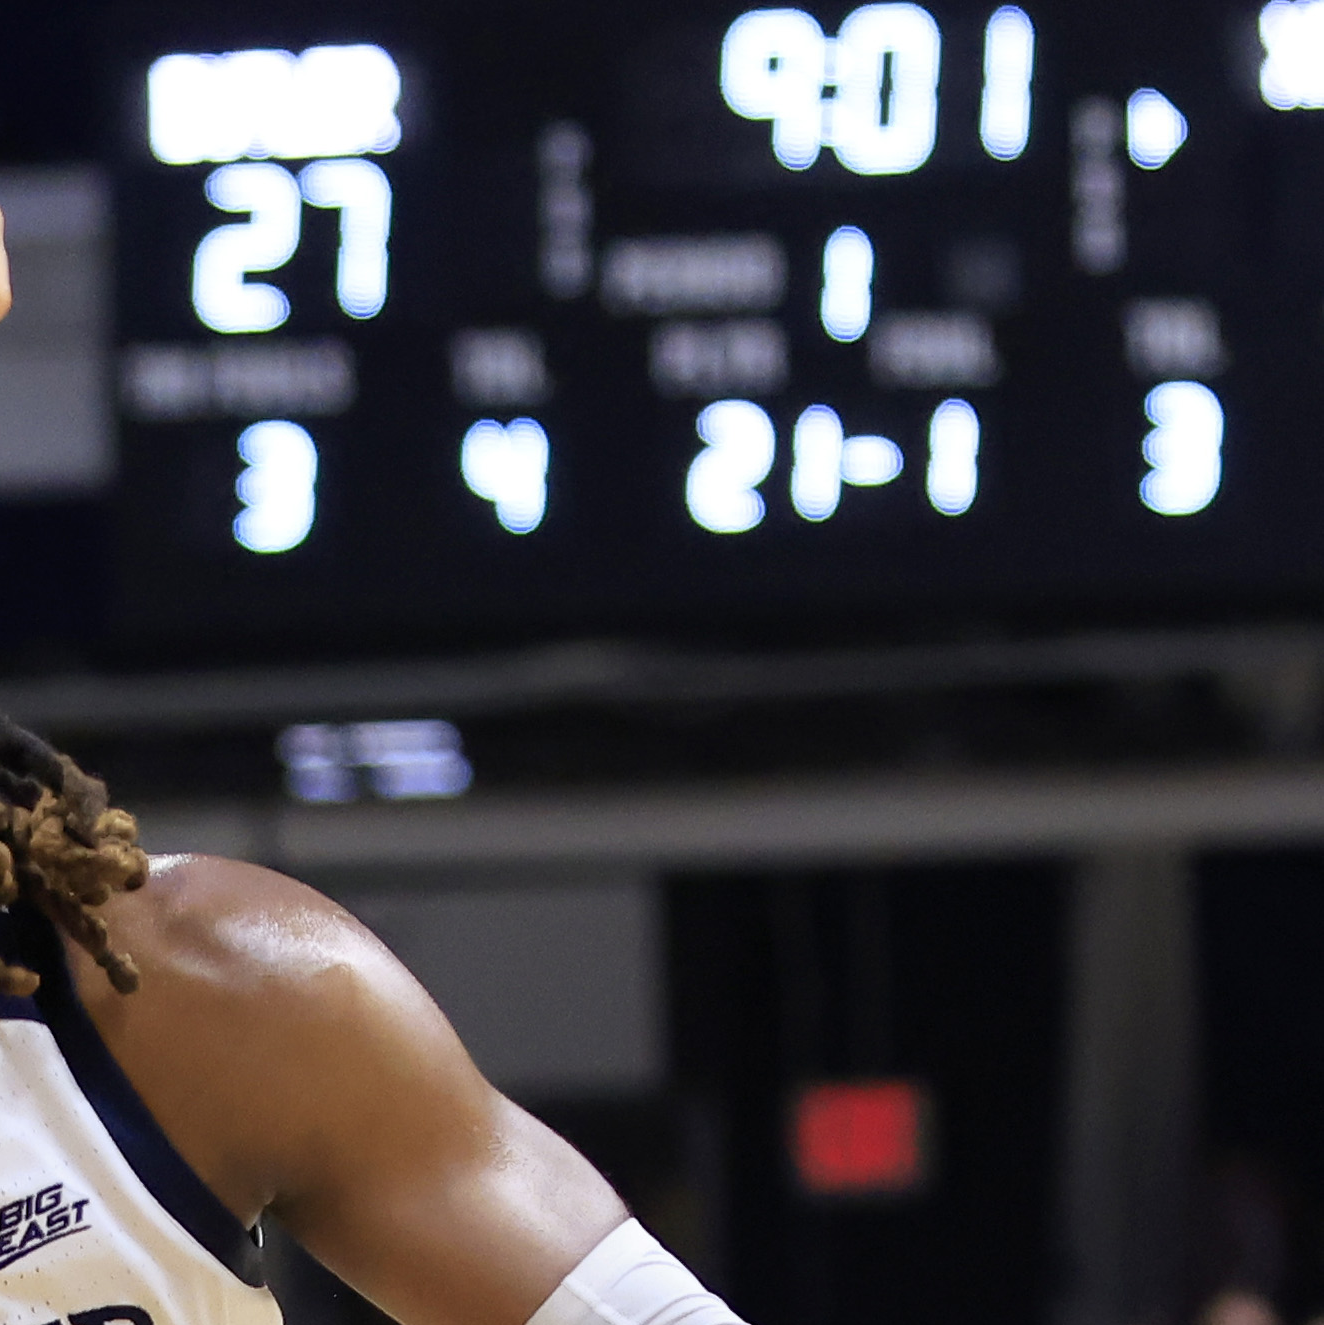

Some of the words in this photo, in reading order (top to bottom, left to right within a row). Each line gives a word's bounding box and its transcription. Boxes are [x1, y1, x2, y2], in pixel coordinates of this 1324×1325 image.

[719, 2, 1035, 176] 9:01
[191, 157, 393, 334] 27
[819, 225, 874, 343] 1
[232, 419, 319, 554] 3
[460, 417, 550, 535] 4
[1138, 380, 1225, 516] 3
